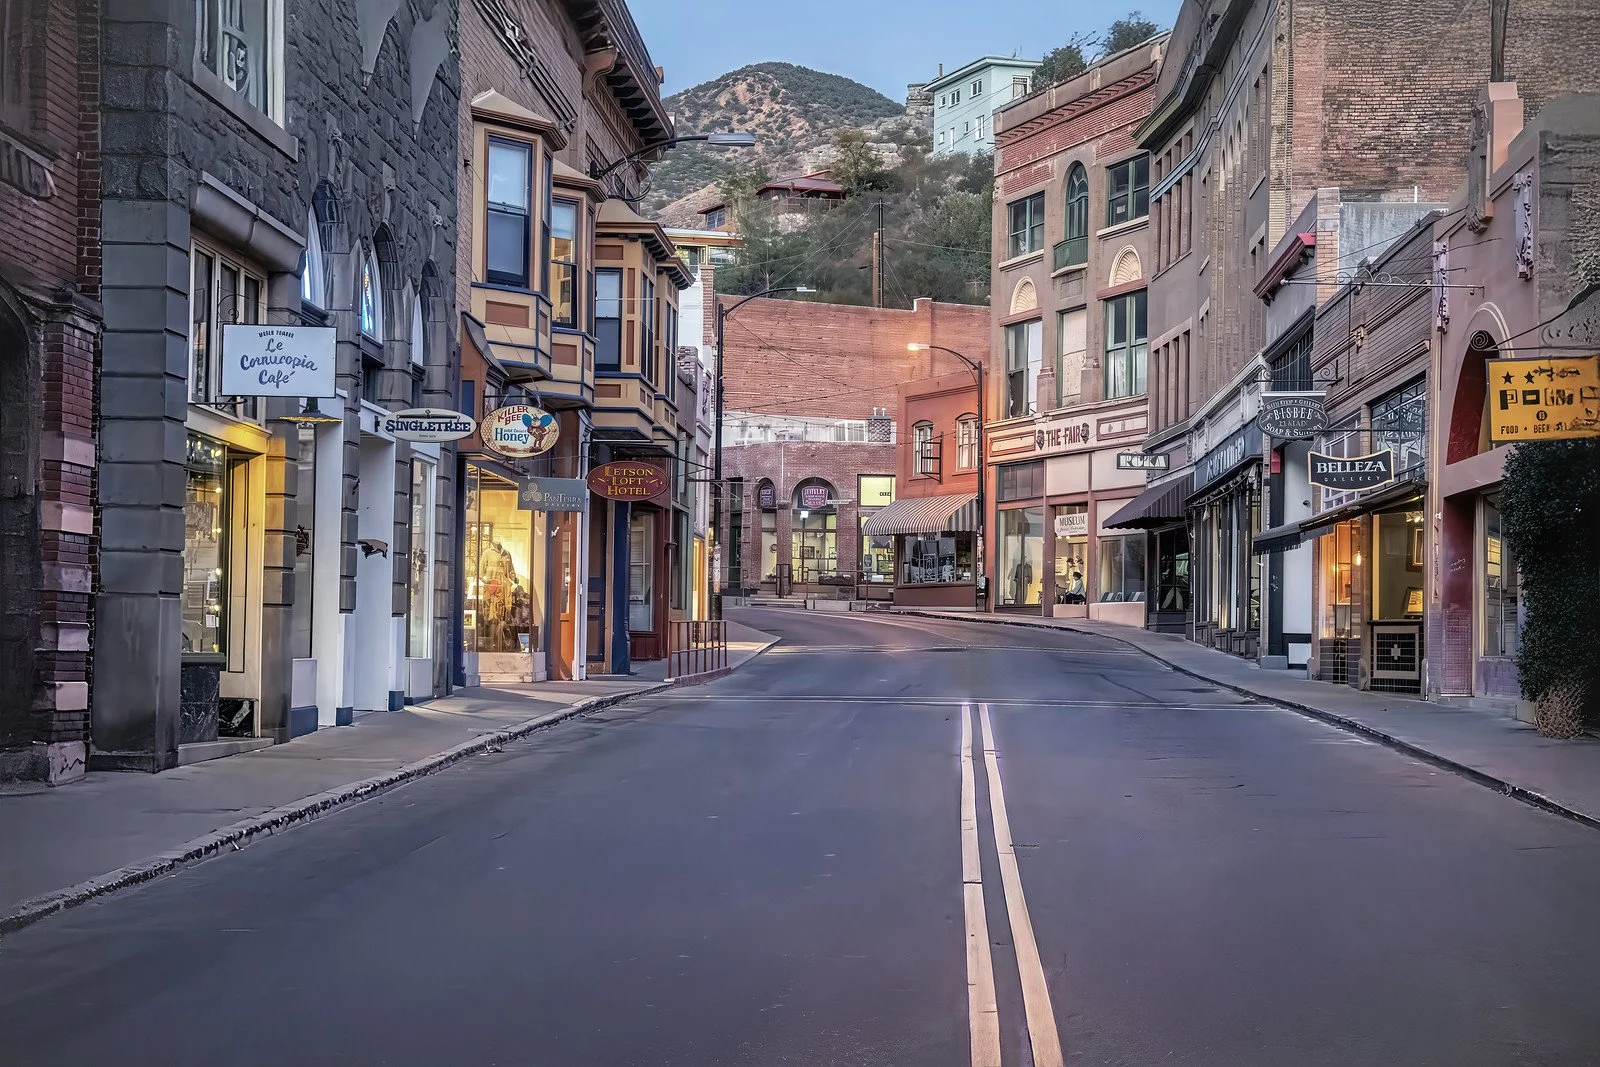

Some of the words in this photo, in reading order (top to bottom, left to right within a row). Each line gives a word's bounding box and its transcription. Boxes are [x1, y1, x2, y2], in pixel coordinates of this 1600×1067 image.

[266, 338, 282, 352] Le
[240, 354, 318, 371] Cornucopia
[258, 370, 295, 388] Café
[498, 406, 528, 422] KILLER
[504, 414, 522, 425] BEE
[385, 420, 470, 433] SINGLETREE
[1264, 423, 1284, 435] SOAP
[1284, 428, 1291, 436] &
[495, 428, 530, 444] Honey
[1046, 428, 1060, 447] THE
[1063, 424, 1080, 444] FAIR
[604, 466, 653, 476] LETSON
[1316, 462, 1387, 474] BELLEZA
[612, 476, 643, 485] LOFT
[608, 486, 650, 496] HOTEL
[1060, 516, 1085, 526] MUSEUM
